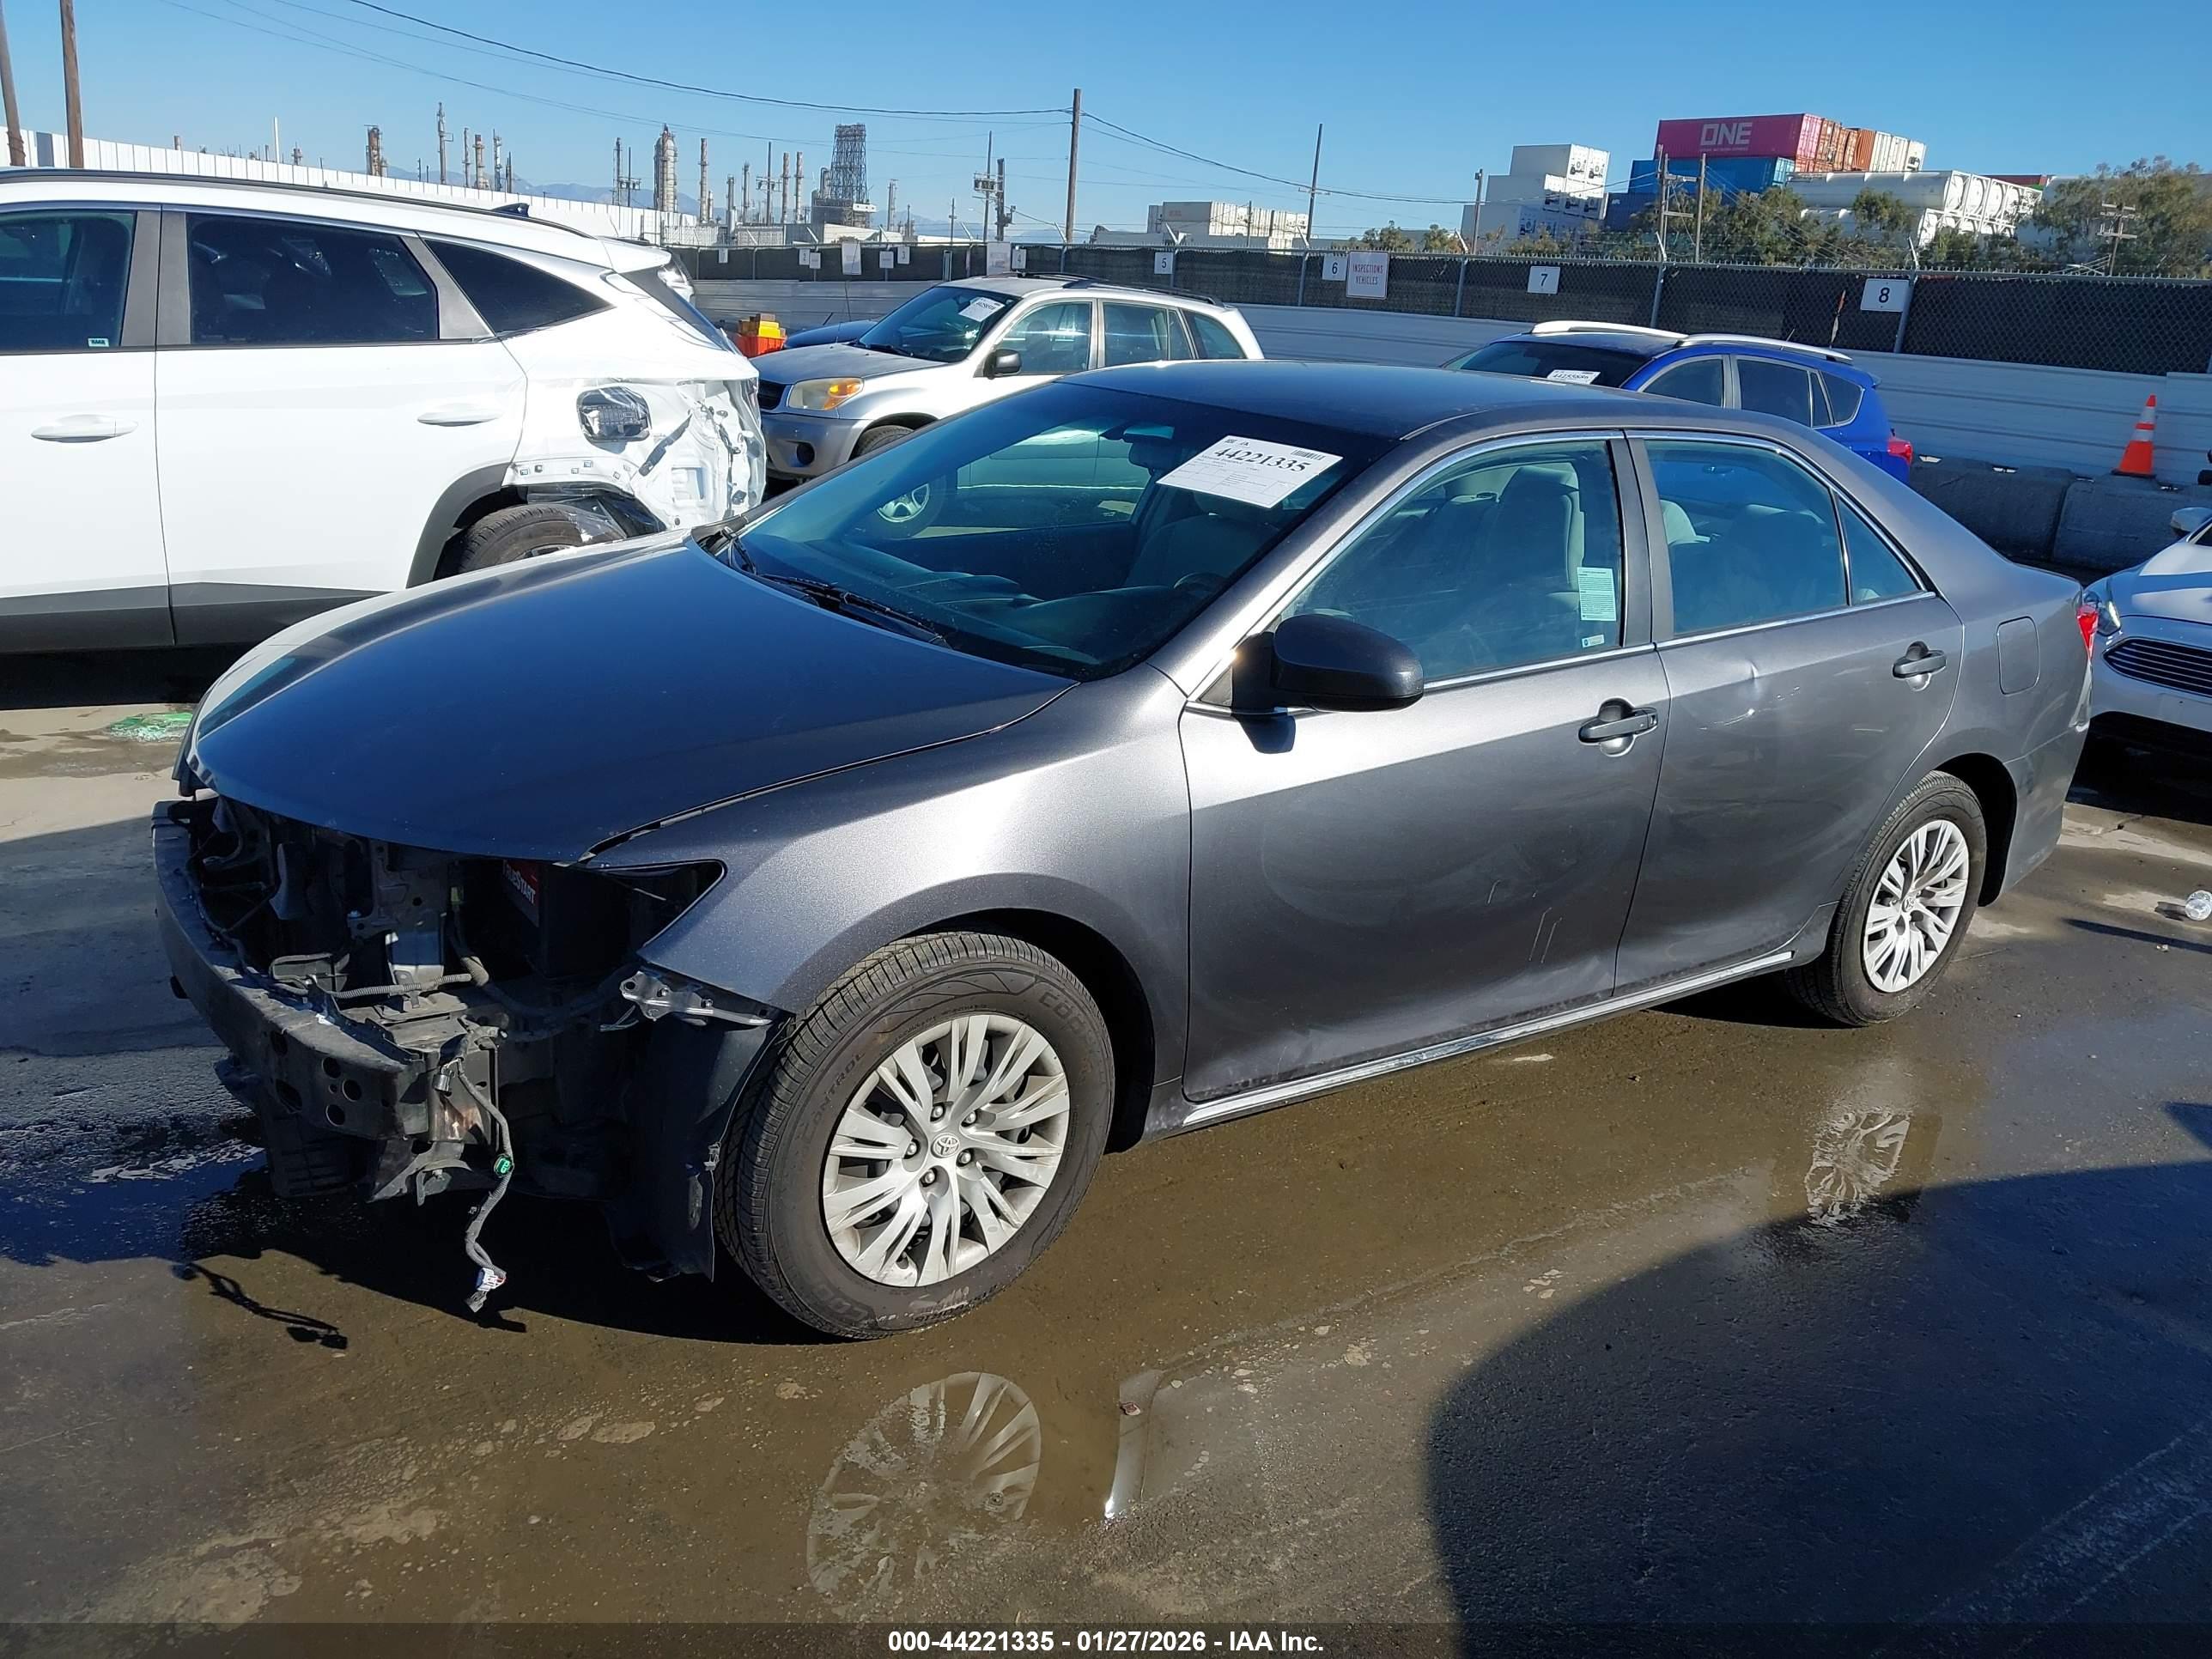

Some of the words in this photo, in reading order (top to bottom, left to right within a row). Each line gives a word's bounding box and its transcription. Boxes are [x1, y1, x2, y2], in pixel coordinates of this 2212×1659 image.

[1700, 122, 1753, 146] ONE
[1161, 258, 1167, 269] 5
[1332, 262, 1338, 274] 6
[1352, 264, 1383, 274] INSPECTIONS
[1355, 276, 1379, 285] VEHICLES
[1540, 273, 1547, 287] 7
[1878, 287, 1890, 303] 8
[1214, 447, 1310, 472] 44221335
